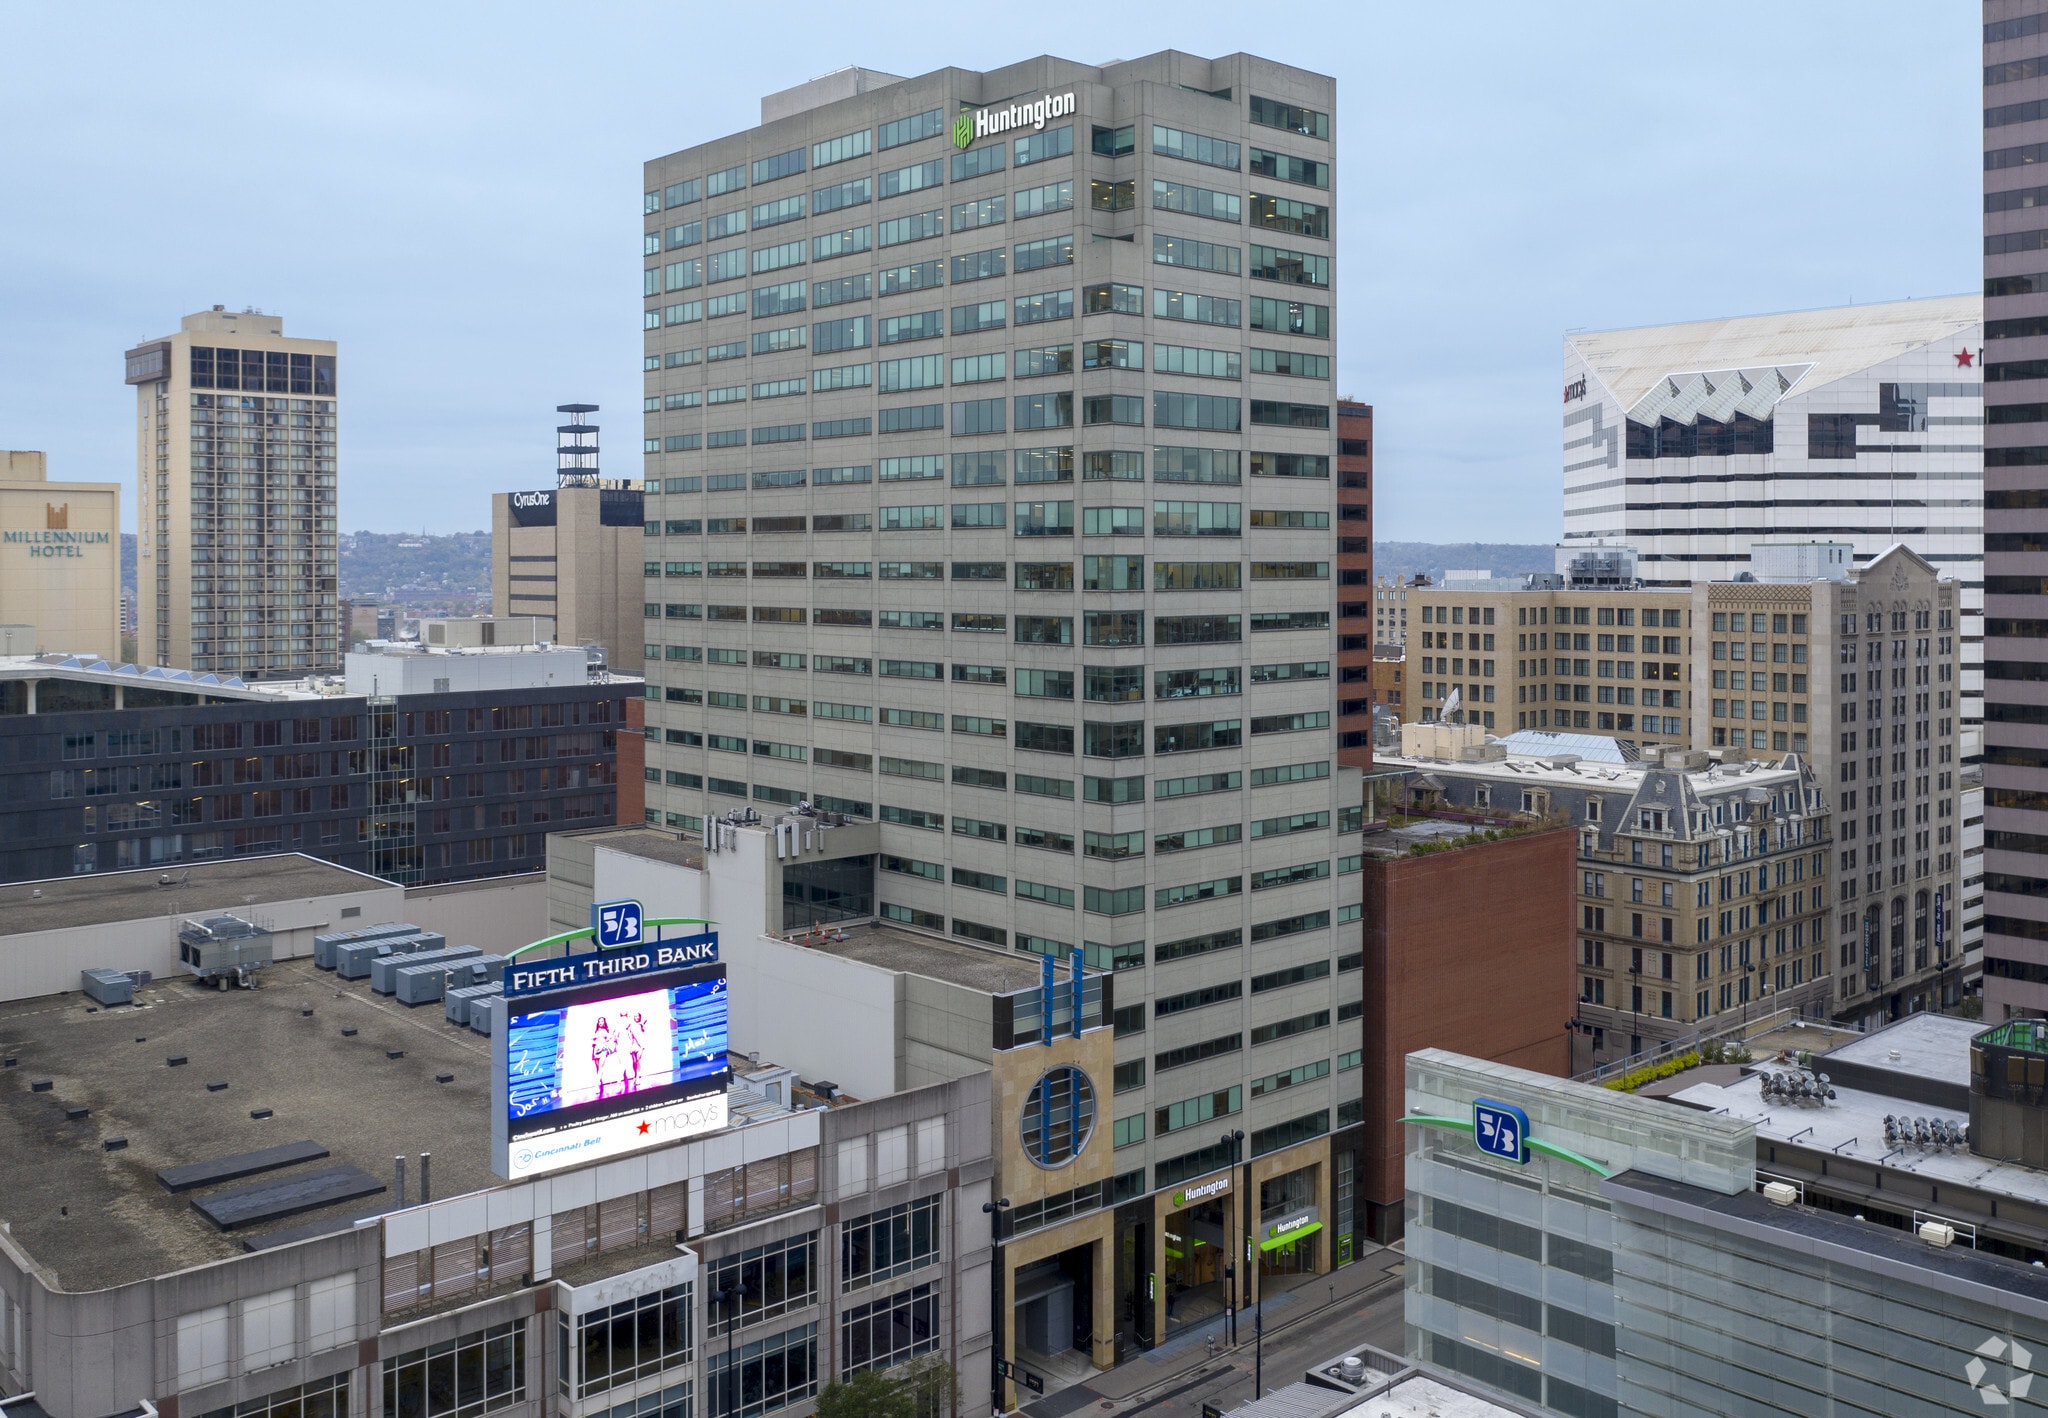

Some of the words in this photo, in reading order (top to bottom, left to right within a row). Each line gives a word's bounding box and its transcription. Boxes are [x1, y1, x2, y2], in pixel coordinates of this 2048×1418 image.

[975, 92, 1075, 138] Huntington
[514, 491, 550, 509] CyrusOne
[3, 531, 109, 543] MILLENNIUM
[30, 545, 83, 557] HOTEL
[513, 966, 575, 990] FIFTH
[584, 954, 650, 978] THIRD
[658, 942, 715, 965] BANK
[655, 1103, 718, 1133] macy's
[535, 1142, 582, 1158] Cincinnati
[583, 1137, 602, 1147] Bell
[1185, 1178, 1229, 1201] Huntington
[1277, 1215, 1309, 1234] Huntington
